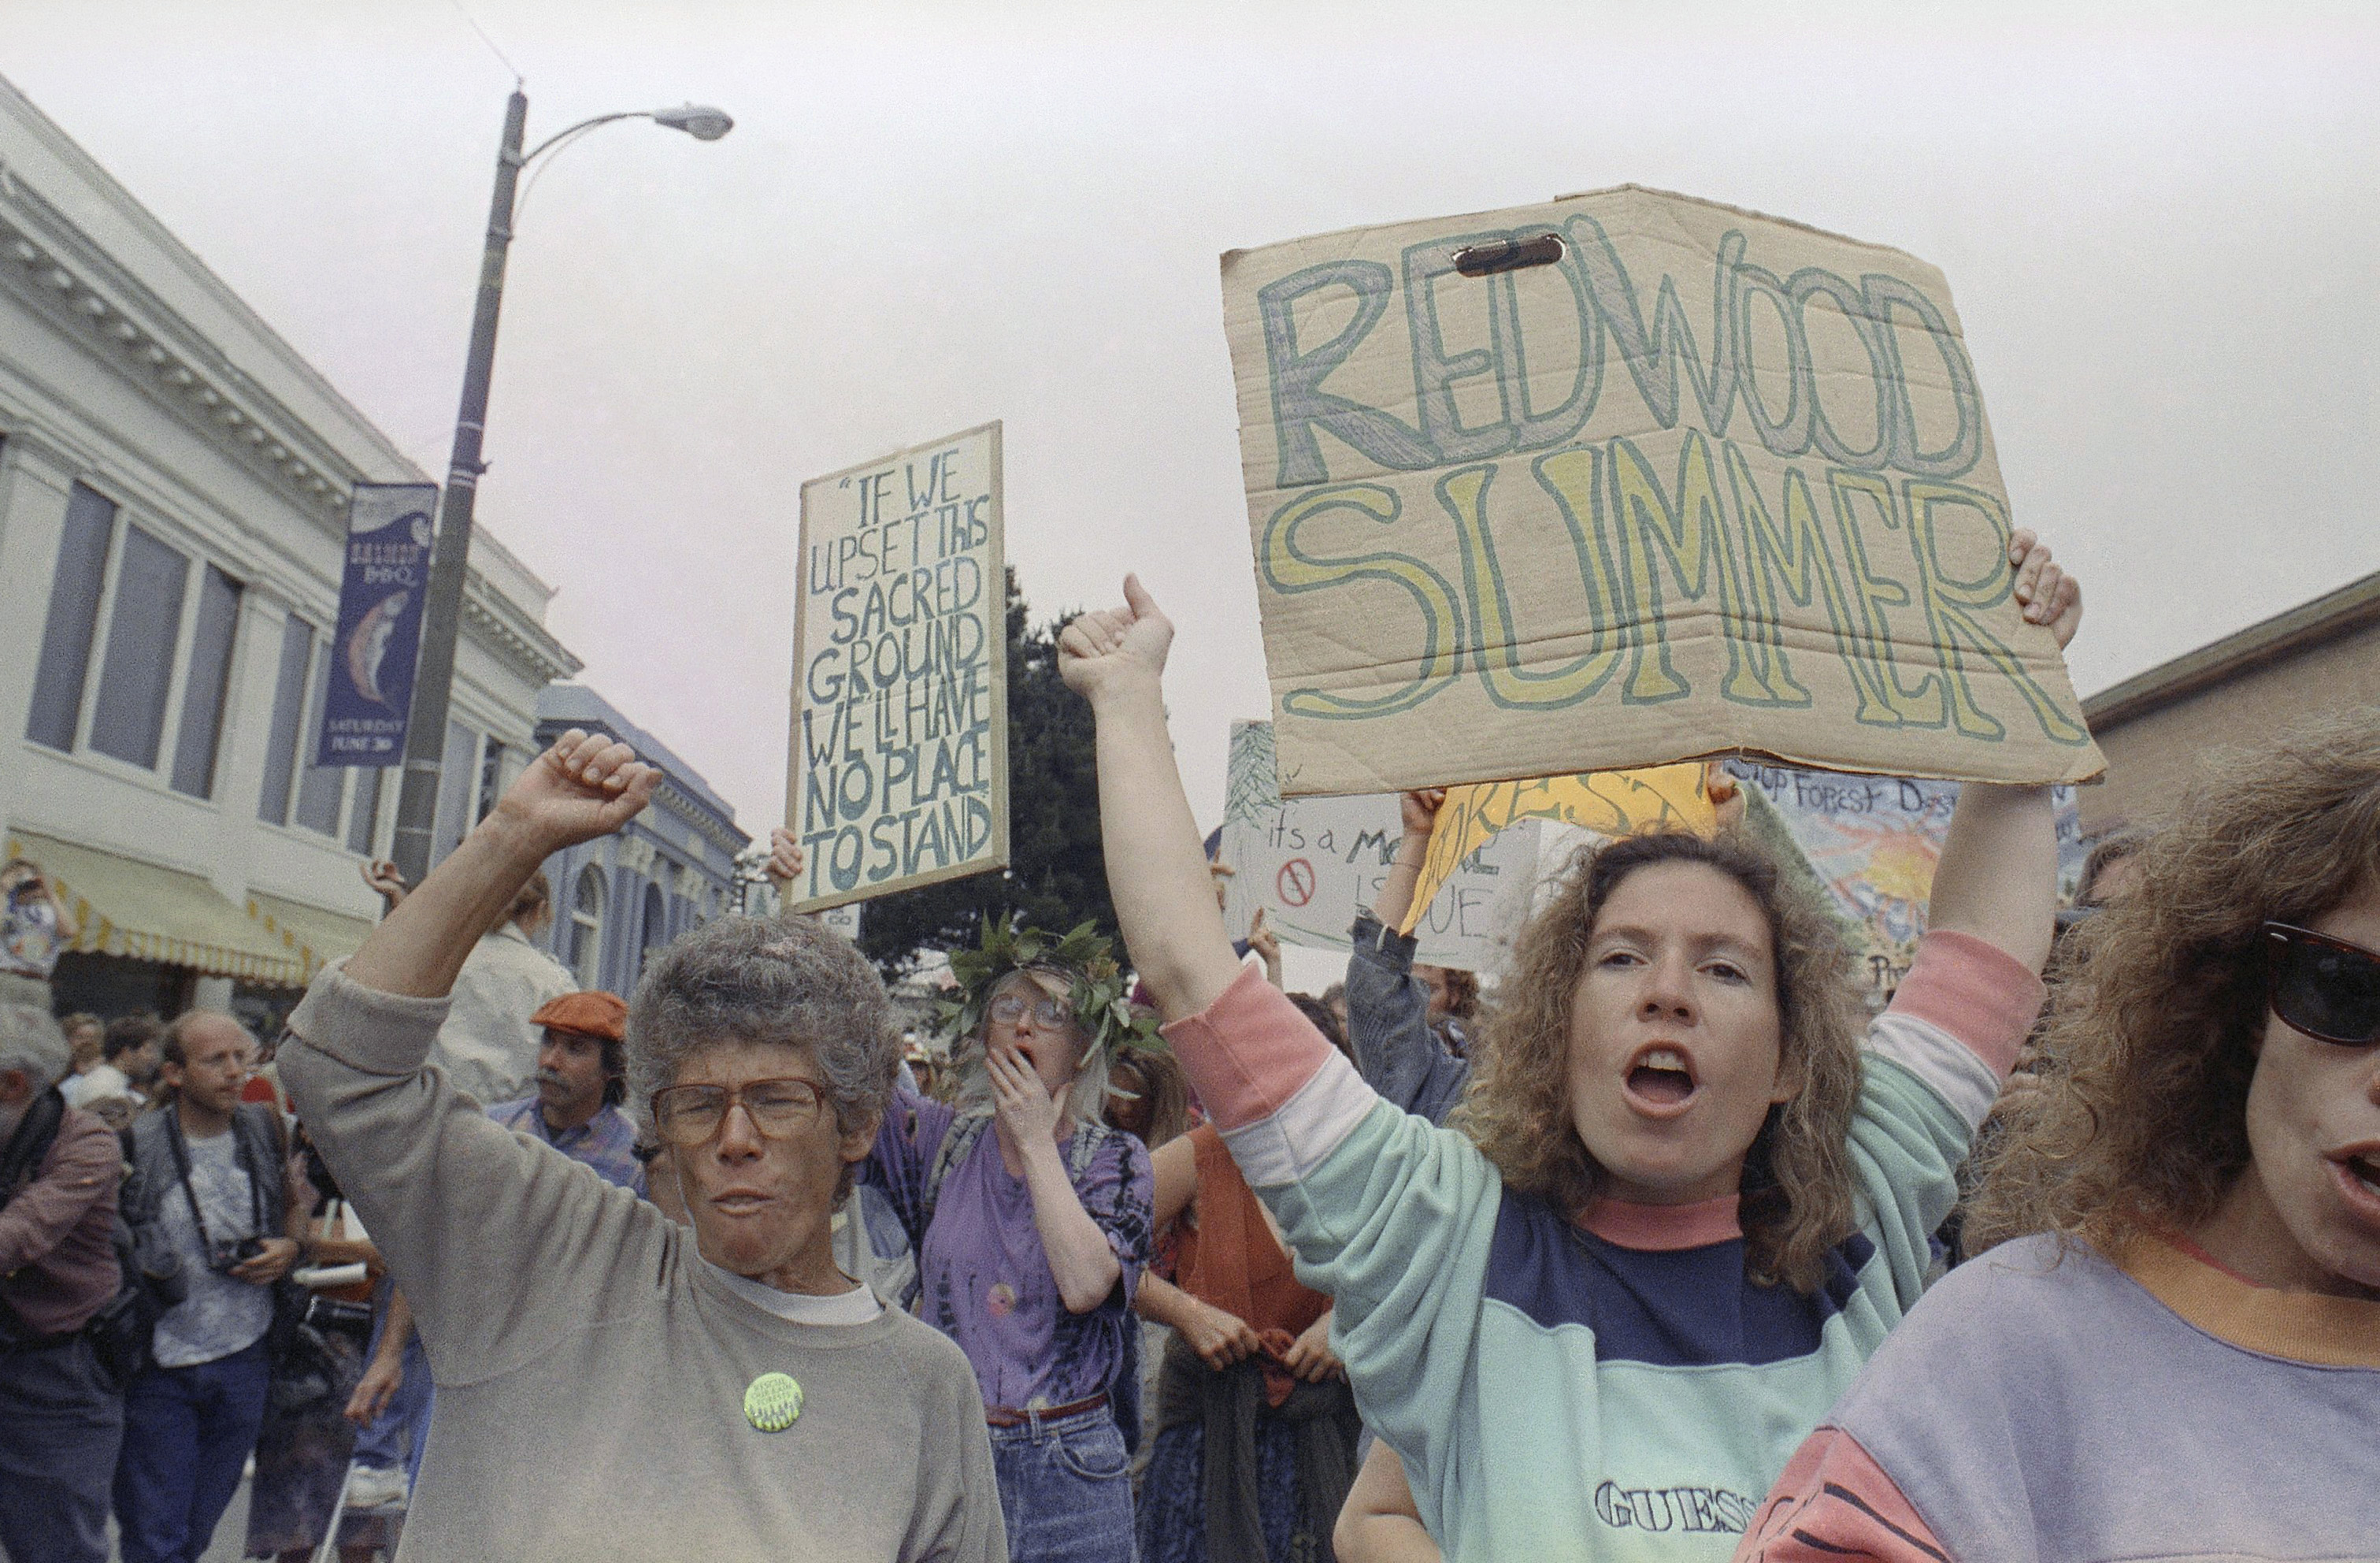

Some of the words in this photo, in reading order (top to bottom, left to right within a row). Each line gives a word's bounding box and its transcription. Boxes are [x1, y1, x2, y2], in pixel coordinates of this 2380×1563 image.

[1258, 213, 1982, 488] REDWOOD
[906, 448, 961, 512] WE
[810, 510, 929, 596] UPSET
[1260, 426, 2087, 743] SUMMER
[830, 555, 981, 644] SACRED
[807, 612, 984, 704] GROUND
[905, 662, 990, 746] HAVE
[805, 760, 874, 833] NO
[881, 720, 990, 814] PLACE
[802, 824, 864, 897] TO
[867, 795, 992, 882] STAND
[1318, 829, 1337, 855] a
